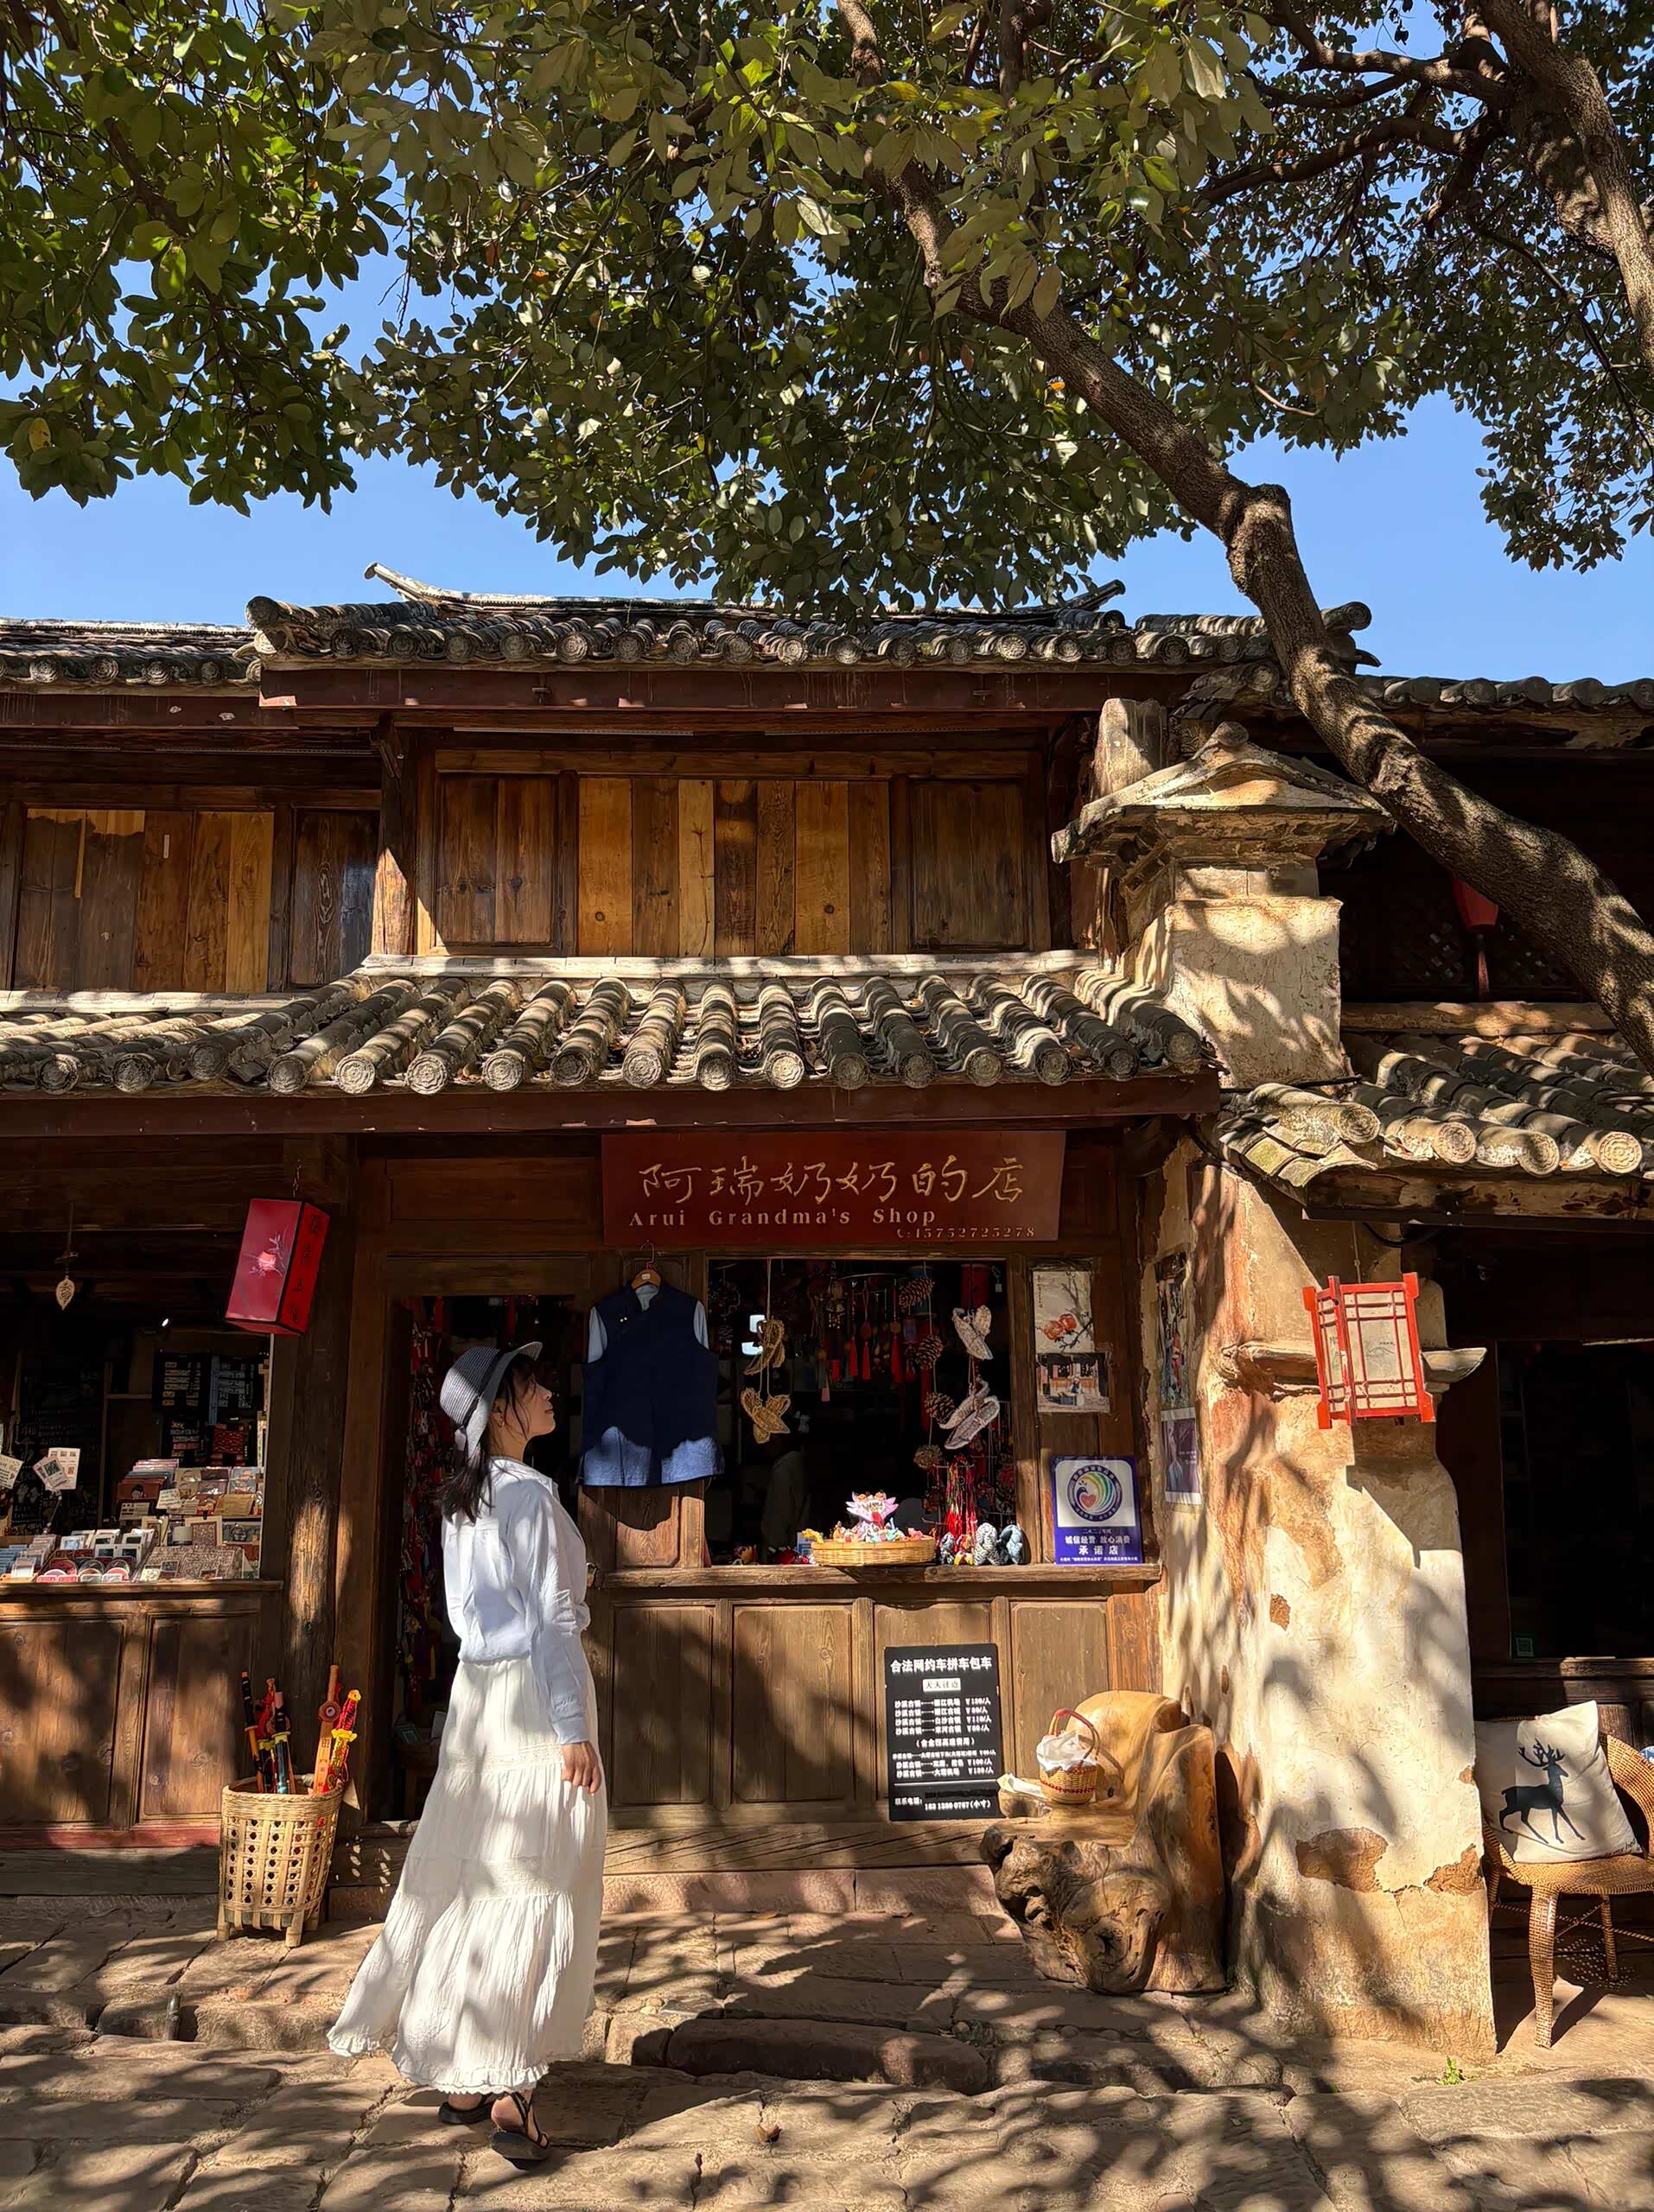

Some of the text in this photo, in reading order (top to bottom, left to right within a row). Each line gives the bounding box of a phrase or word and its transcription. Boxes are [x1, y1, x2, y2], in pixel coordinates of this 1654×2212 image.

[638, 1154, 1025, 1205] 阿瑞奶奶的店
[628, 1208, 936, 1227] Arui Grandma's Shop
[1065, 1535, 1131, 1545] 诚信经营 放心消费
[1078, 1545, 1119, 1555] 承诺店
[890, 1656, 992, 1673] 合法网约车拼车包车
